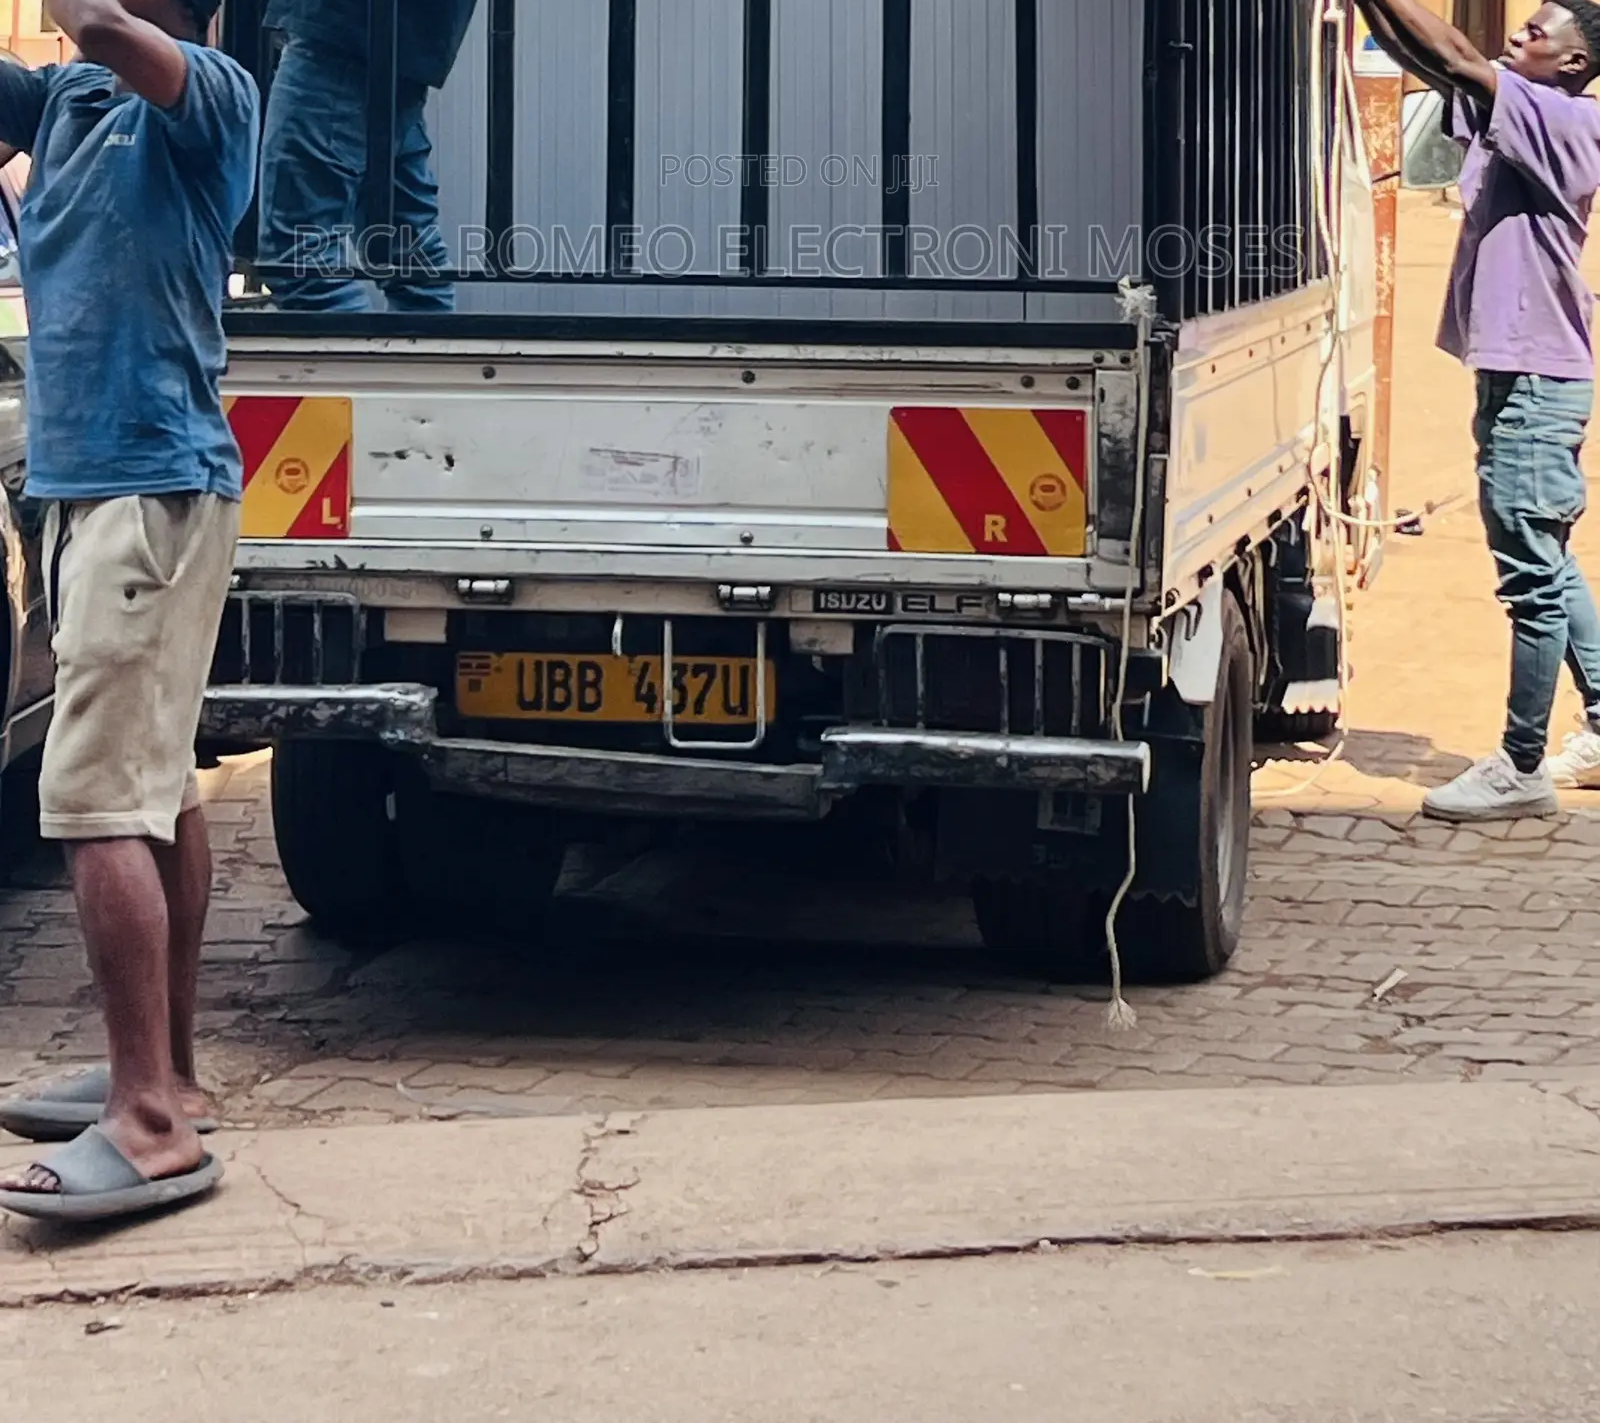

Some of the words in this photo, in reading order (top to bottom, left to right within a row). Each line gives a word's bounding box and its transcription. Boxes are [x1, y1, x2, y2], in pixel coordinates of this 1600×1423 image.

[321, 497, 340, 525] L
[984, 513, 1007, 542] R
[820, 592, 887, 611] ISUZU
[901, 594, 984, 614] ELF
[516, 658, 603, 713] UBB
[634, 661, 749, 716] 437U
